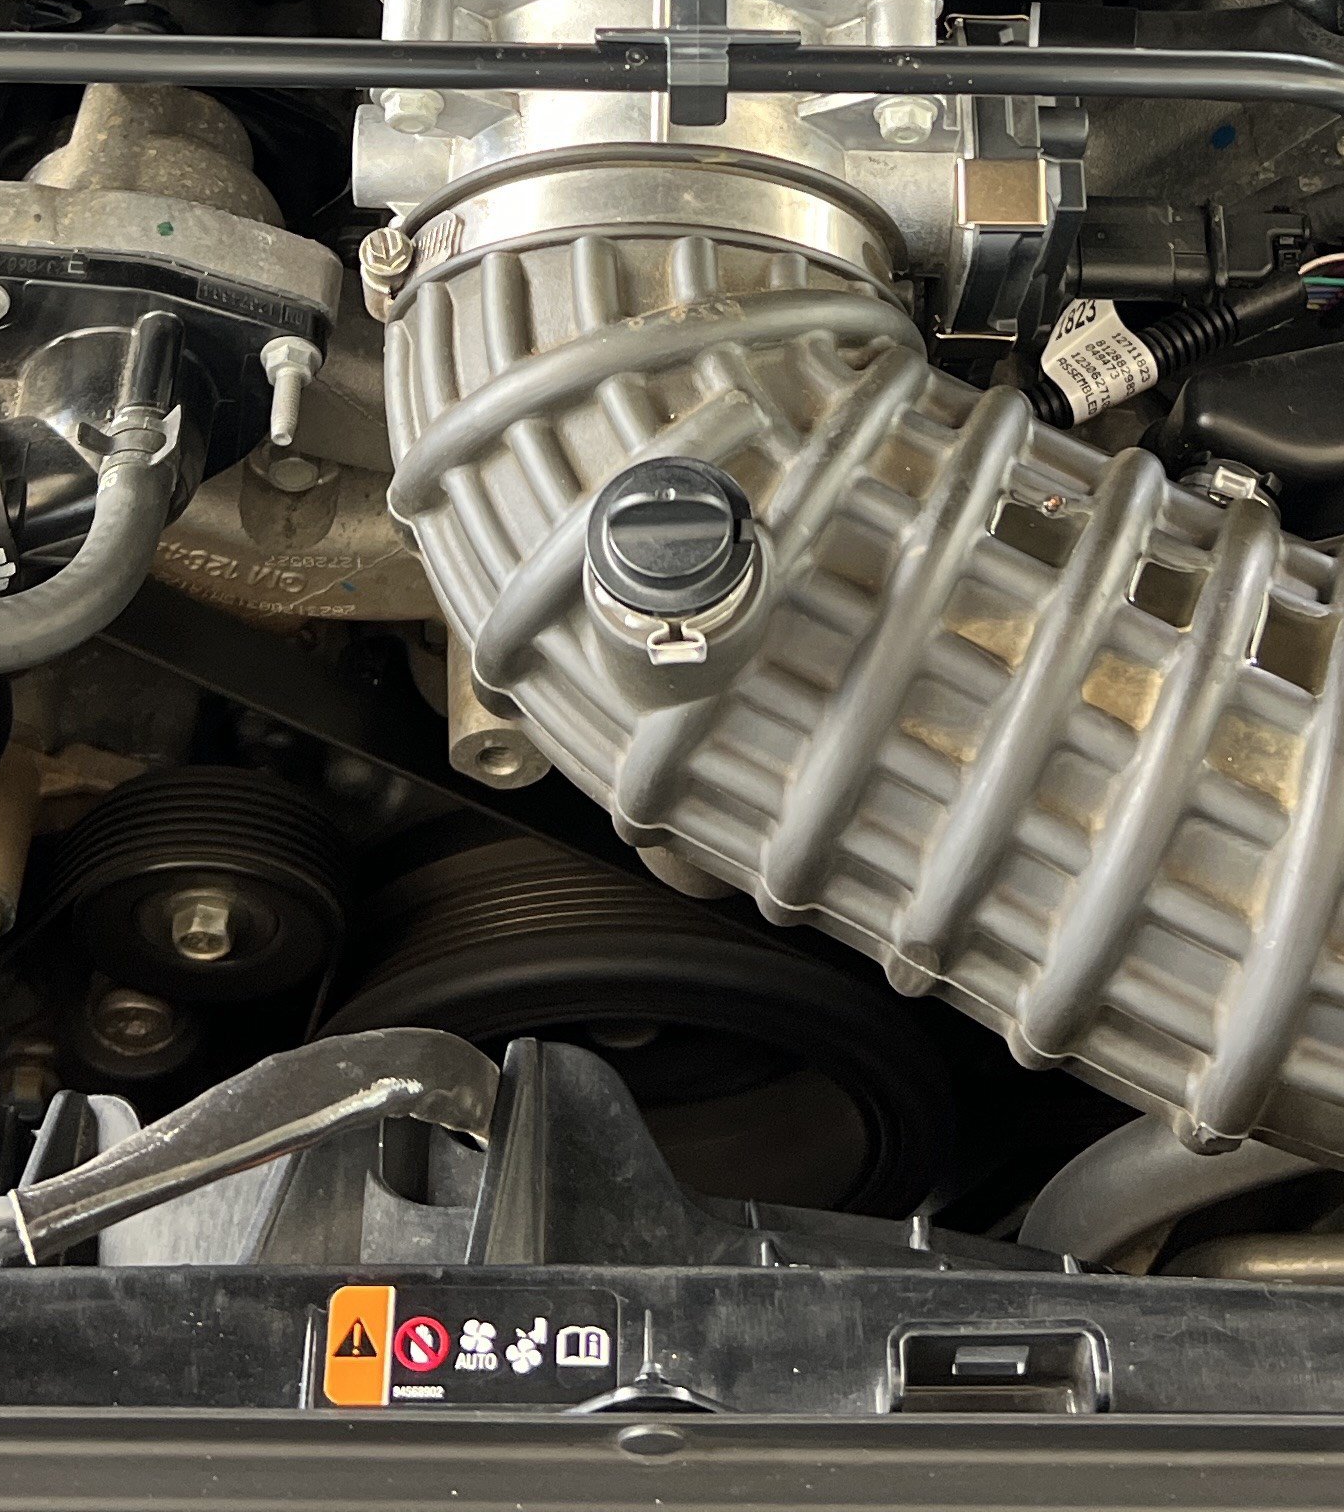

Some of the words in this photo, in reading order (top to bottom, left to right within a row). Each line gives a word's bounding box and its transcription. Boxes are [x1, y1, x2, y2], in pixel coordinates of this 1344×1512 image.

[1112, 332, 1151, 383] 12711823
[1057, 356, 1098, 415] ASSEMBLED
[454, 1352, 498, 1371] AUTO
